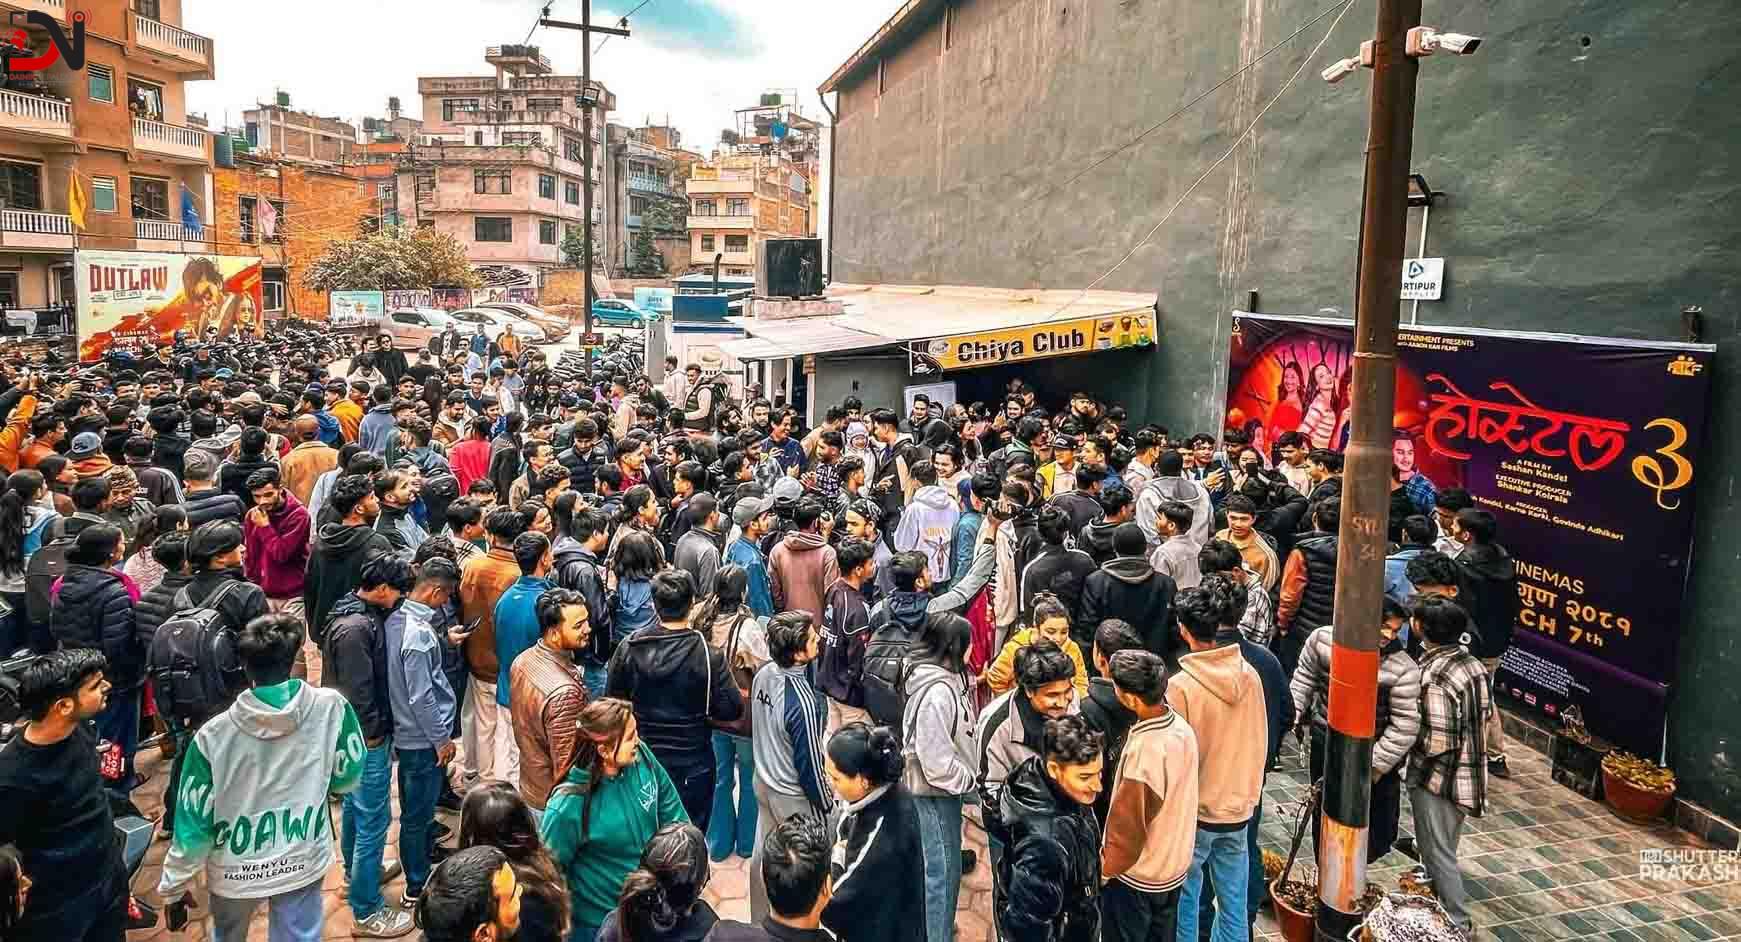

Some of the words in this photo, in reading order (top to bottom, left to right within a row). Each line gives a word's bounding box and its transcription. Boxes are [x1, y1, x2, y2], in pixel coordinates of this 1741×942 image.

[90, 264, 168, 292] OUTLAW
[1402, 281, 1436, 290] RTIPUR
[957, 338, 1025, 363] Chiya
[1032, 328, 1084, 353] Club
[1397, 333, 1441, 344] ERTAINMENT
[1442, 337, 1475, 347] PRESENTS
[1424, 373, 1632, 471] होस्टेल
[1631, 418, 1694, 510] ३
[1495, 473, 1532, 488] EXECUTIVE
[1532, 480, 1573, 497] PRODUCER
[1496, 480, 1534, 495] Shankar
[1535, 468, 1569, 483] Kandel
[1512, 559, 1585, 595] INEMAS
[1517, 580, 1559, 609] गुण
[1565, 600, 1632, 637] २०८१
[1518, 608, 1557, 636] CH
[1568, 625, 1603, 647] 7th
[224, 872, 263, 882] FASHION
[265, 864, 305, 878] LEADER
